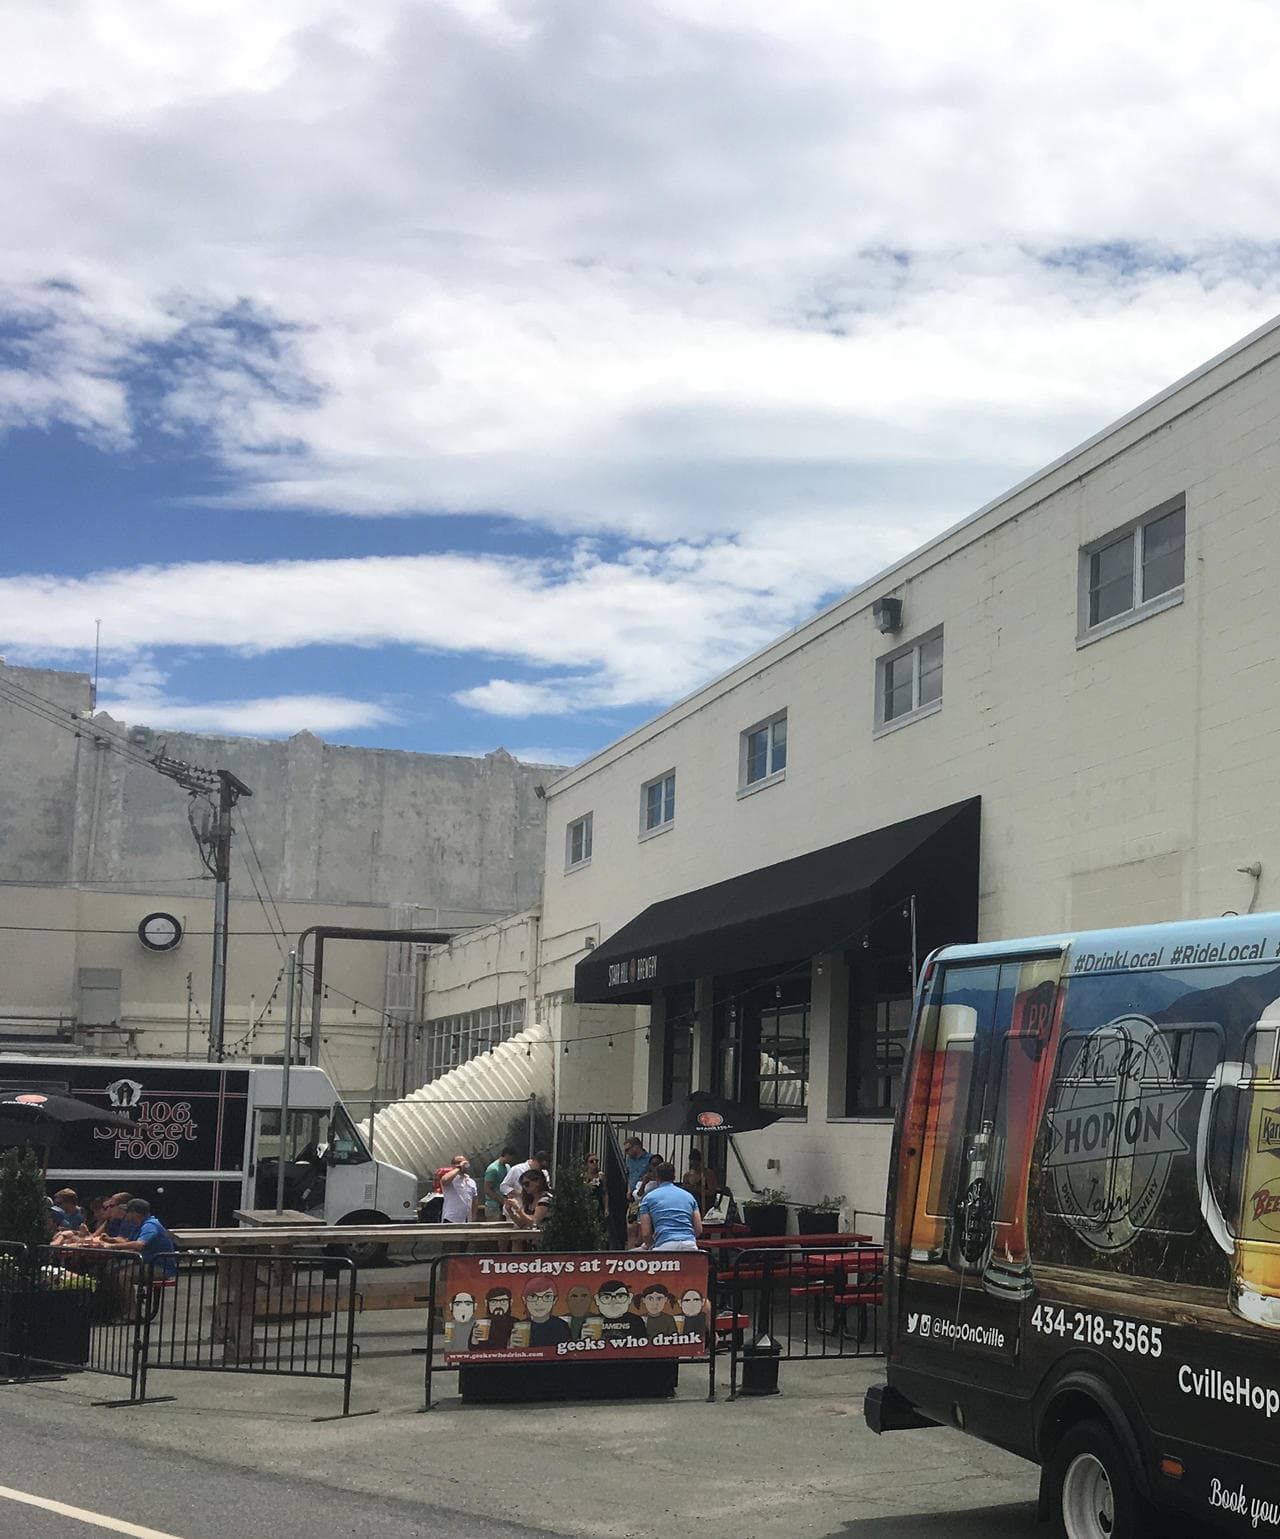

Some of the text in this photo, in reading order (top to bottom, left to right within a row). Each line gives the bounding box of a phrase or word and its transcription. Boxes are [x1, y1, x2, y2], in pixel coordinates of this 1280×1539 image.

[1074, 946, 1163, 973] #DrinkLocal
[1170, 938, 1267, 966] #RideLocal
[138, 1101, 192, 1123] 106
[1064, 1103, 1164, 1154] HOP ON
[114, 1140, 180, 1160] FOOD
[479, 1258, 681, 1276] Tuesdays at 7:00pm
[557, 1331, 702, 1355] geeks who drink
[933, 1319, 1005, 1348] @HopOnCville
[1031, 1304, 1163, 1358] 434-218-3565
[1208, 1477, 1248, 1515] Book
